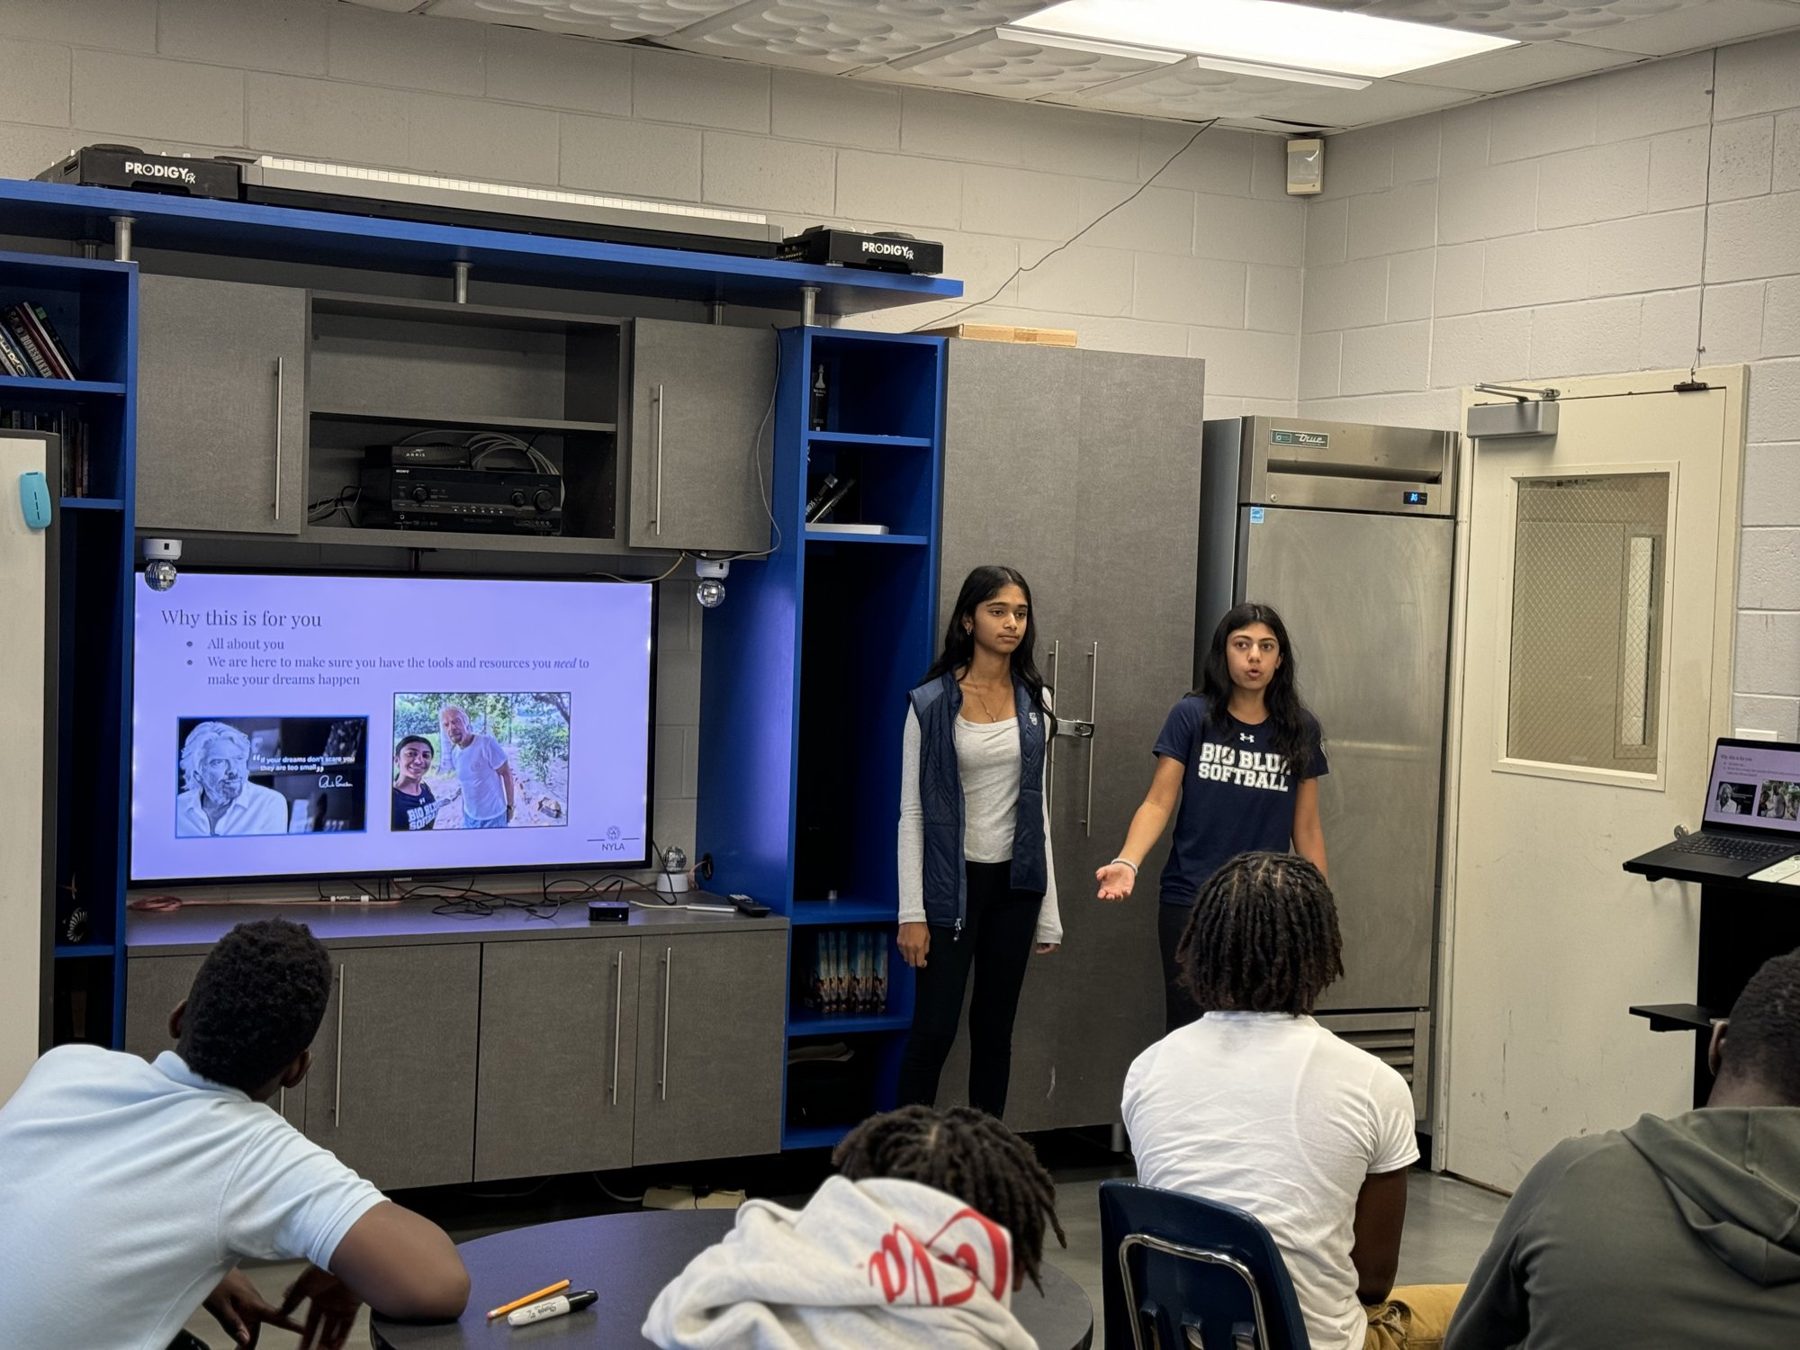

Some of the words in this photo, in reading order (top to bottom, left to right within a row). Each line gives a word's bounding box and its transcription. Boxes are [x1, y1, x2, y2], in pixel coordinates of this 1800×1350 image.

[125, 162, 188, 180] PRODIGY
[862, 242, 909, 256] PRODIGY
[161, 610, 200, 628] Why
[206, 610, 238, 626] this
[243, 610, 257, 626] is
[262, 610, 287, 626] for
[291, 614, 322, 630] you
[207, 638, 224, 650] All
[227, 638, 260, 650] about
[264, 641, 285, 652] you
[207, 656, 226, 668] We
[228, 659, 248, 668] are
[251, 656, 277, 668] here
[280, 657, 292, 668] to
[295, 656, 326, 668] make
[328, 659, 352, 668] sure
[355, 659, 376, 670] you
[379, 657, 404, 668] have
[407, 657, 425, 668] the
[428, 657, 454, 669] tools
[456, 658, 476, 669] and
[479, 660, 530, 669] resources
[532, 660, 552, 670] you
[553, 658, 577, 669] need
[579, 658, 590, 669] to
[208, 674, 240, 685] make
[242, 676, 270, 687] your
[272, 674, 316, 686] dreams
[318, 674, 360, 688] happen
[1200, 742, 1235, 766] BIG
[1238, 749, 1292, 776] BLU
[1198, 762, 1289, 792] SOFTBALL
[602, 843, 625, 852] NYLA
